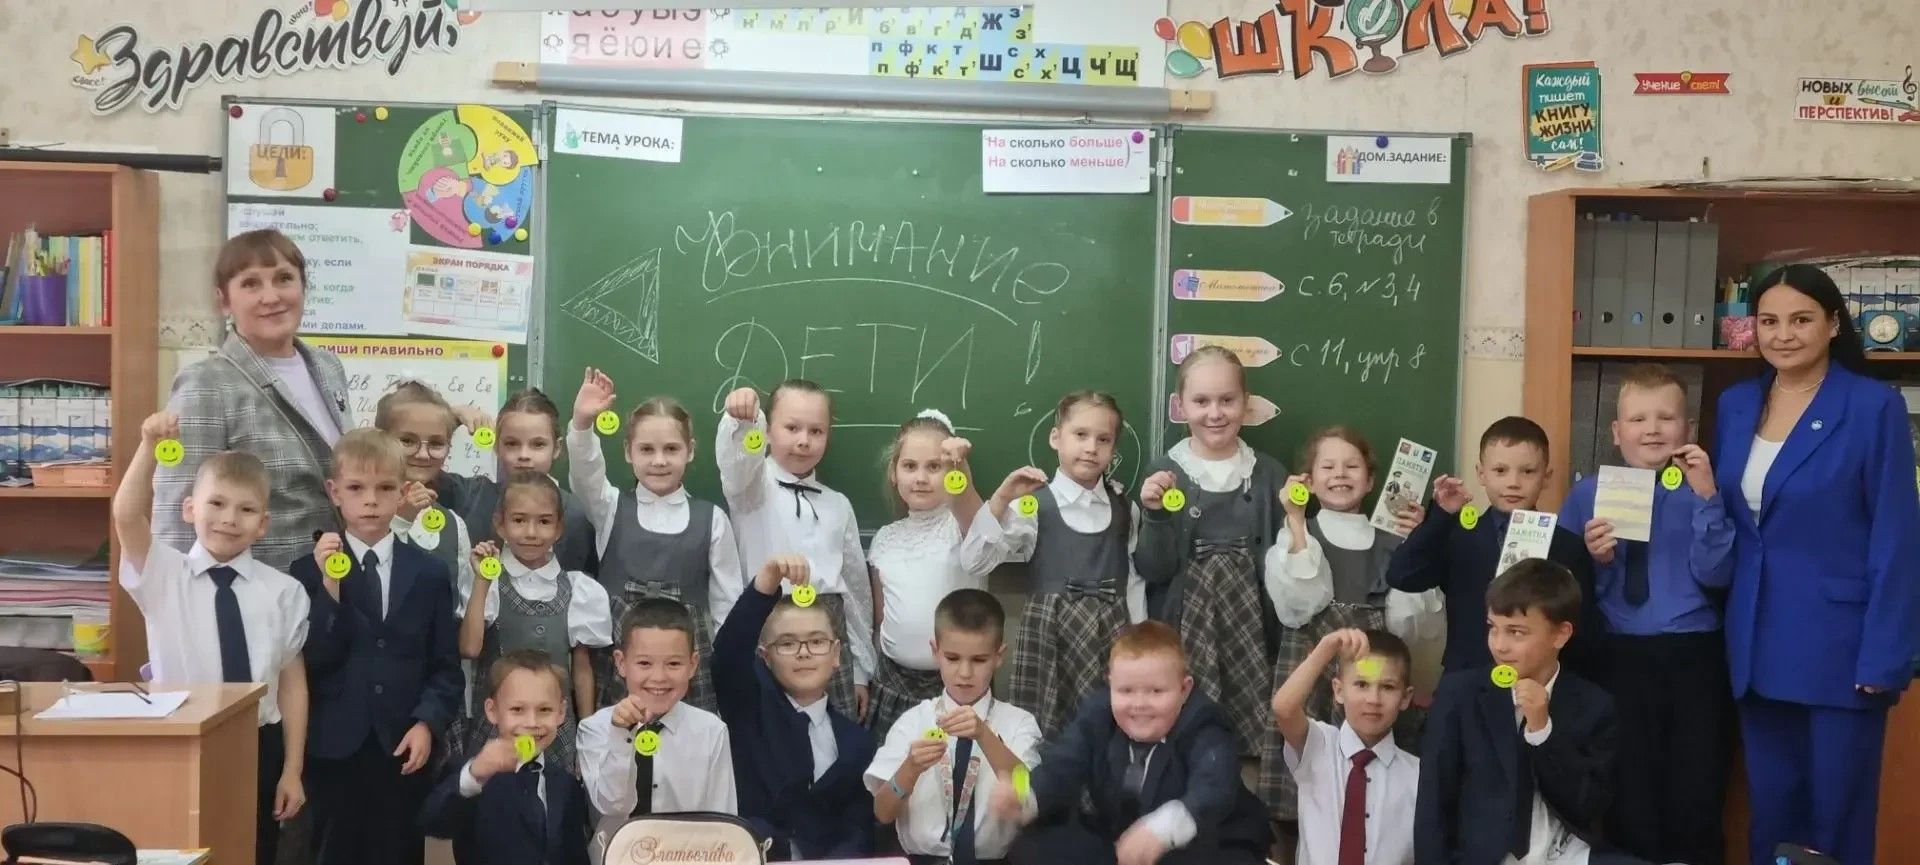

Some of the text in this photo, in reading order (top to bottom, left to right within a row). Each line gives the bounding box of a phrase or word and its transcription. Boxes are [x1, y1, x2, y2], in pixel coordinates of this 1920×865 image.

[95, 0, 458, 110] Здравствуй,
[1536, 72, 1590, 91] Каждый
[1802, 80, 1853, 94] НОВЫХ
[1539, 92, 1585, 104] пишет
[1535, 103, 1590, 124] КНИГУ
[1799, 106, 1894, 120] ПЕРСПЕКТИВ!
[1539, 119, 1593, 139] ЖИЗНИ
[582, 131, 675, 150] ТЕМА УРОКА:
[987, 136, 1123, 148] На сколько больше
[1551, 137, 1584, 151] сам!
[256, 144, 306, 160] ЦЕЛИ:
[1359, 151, 1447, 163] ДОМ.ЗАДАНИЕ:
[988, 156, 1124, 168] На сколько меньше
[324, 259, 352, 267] если
[433, 257, 510, 271] ЭКРАН ПОРЯДКА
[363, 345, 444, 356] ПРАВИЛЬНО
